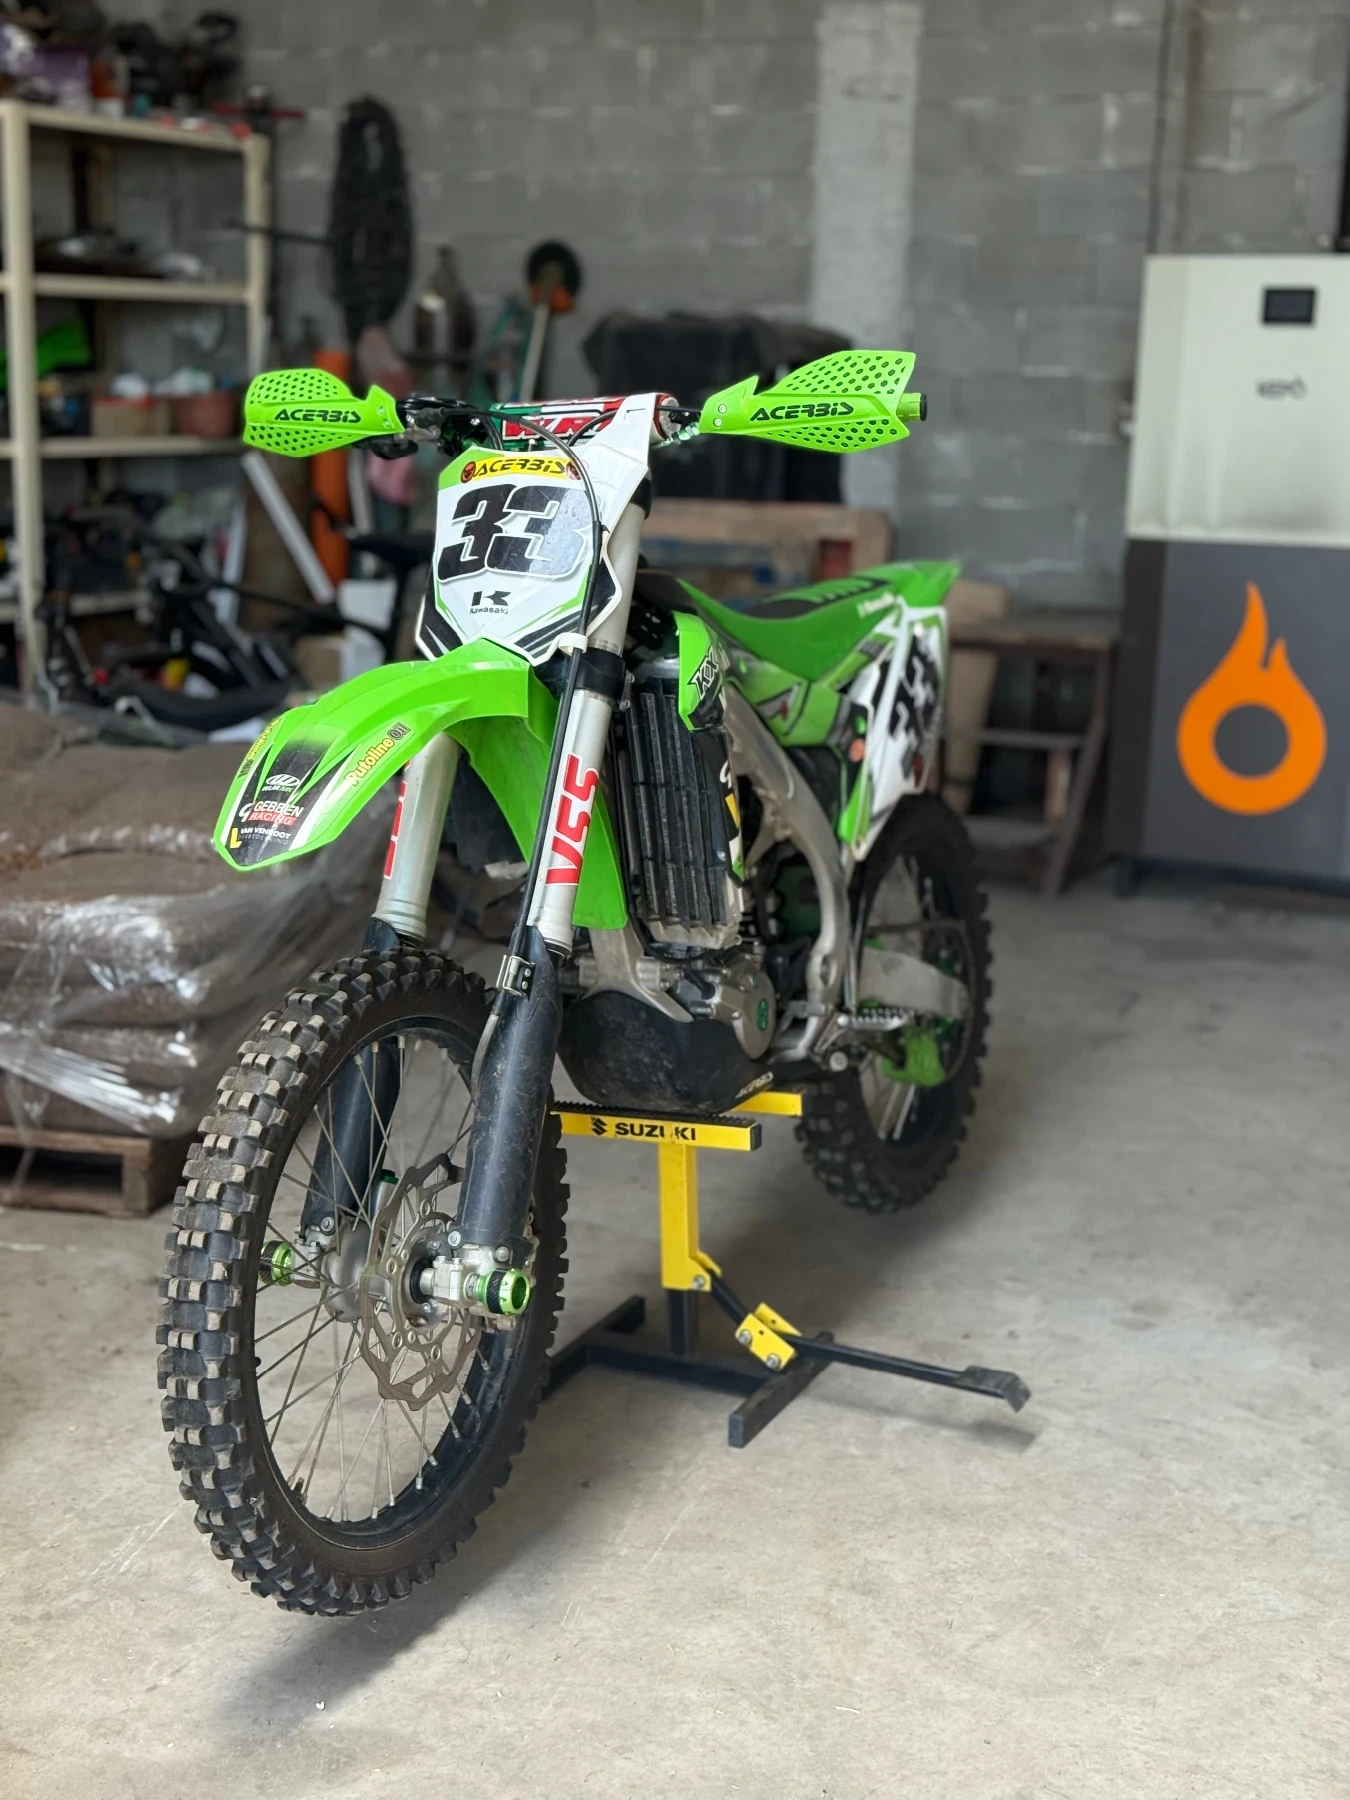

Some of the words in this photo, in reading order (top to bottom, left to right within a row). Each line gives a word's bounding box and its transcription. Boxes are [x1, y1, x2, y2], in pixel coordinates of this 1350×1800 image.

[503, 415, 618, 438] WR
[438, 484, 592, 581] 33
[250, 811, 292, 826] RACING
[254, 801, 304, 818] GEBBEN
[545, 753, 599, 885] VSS
